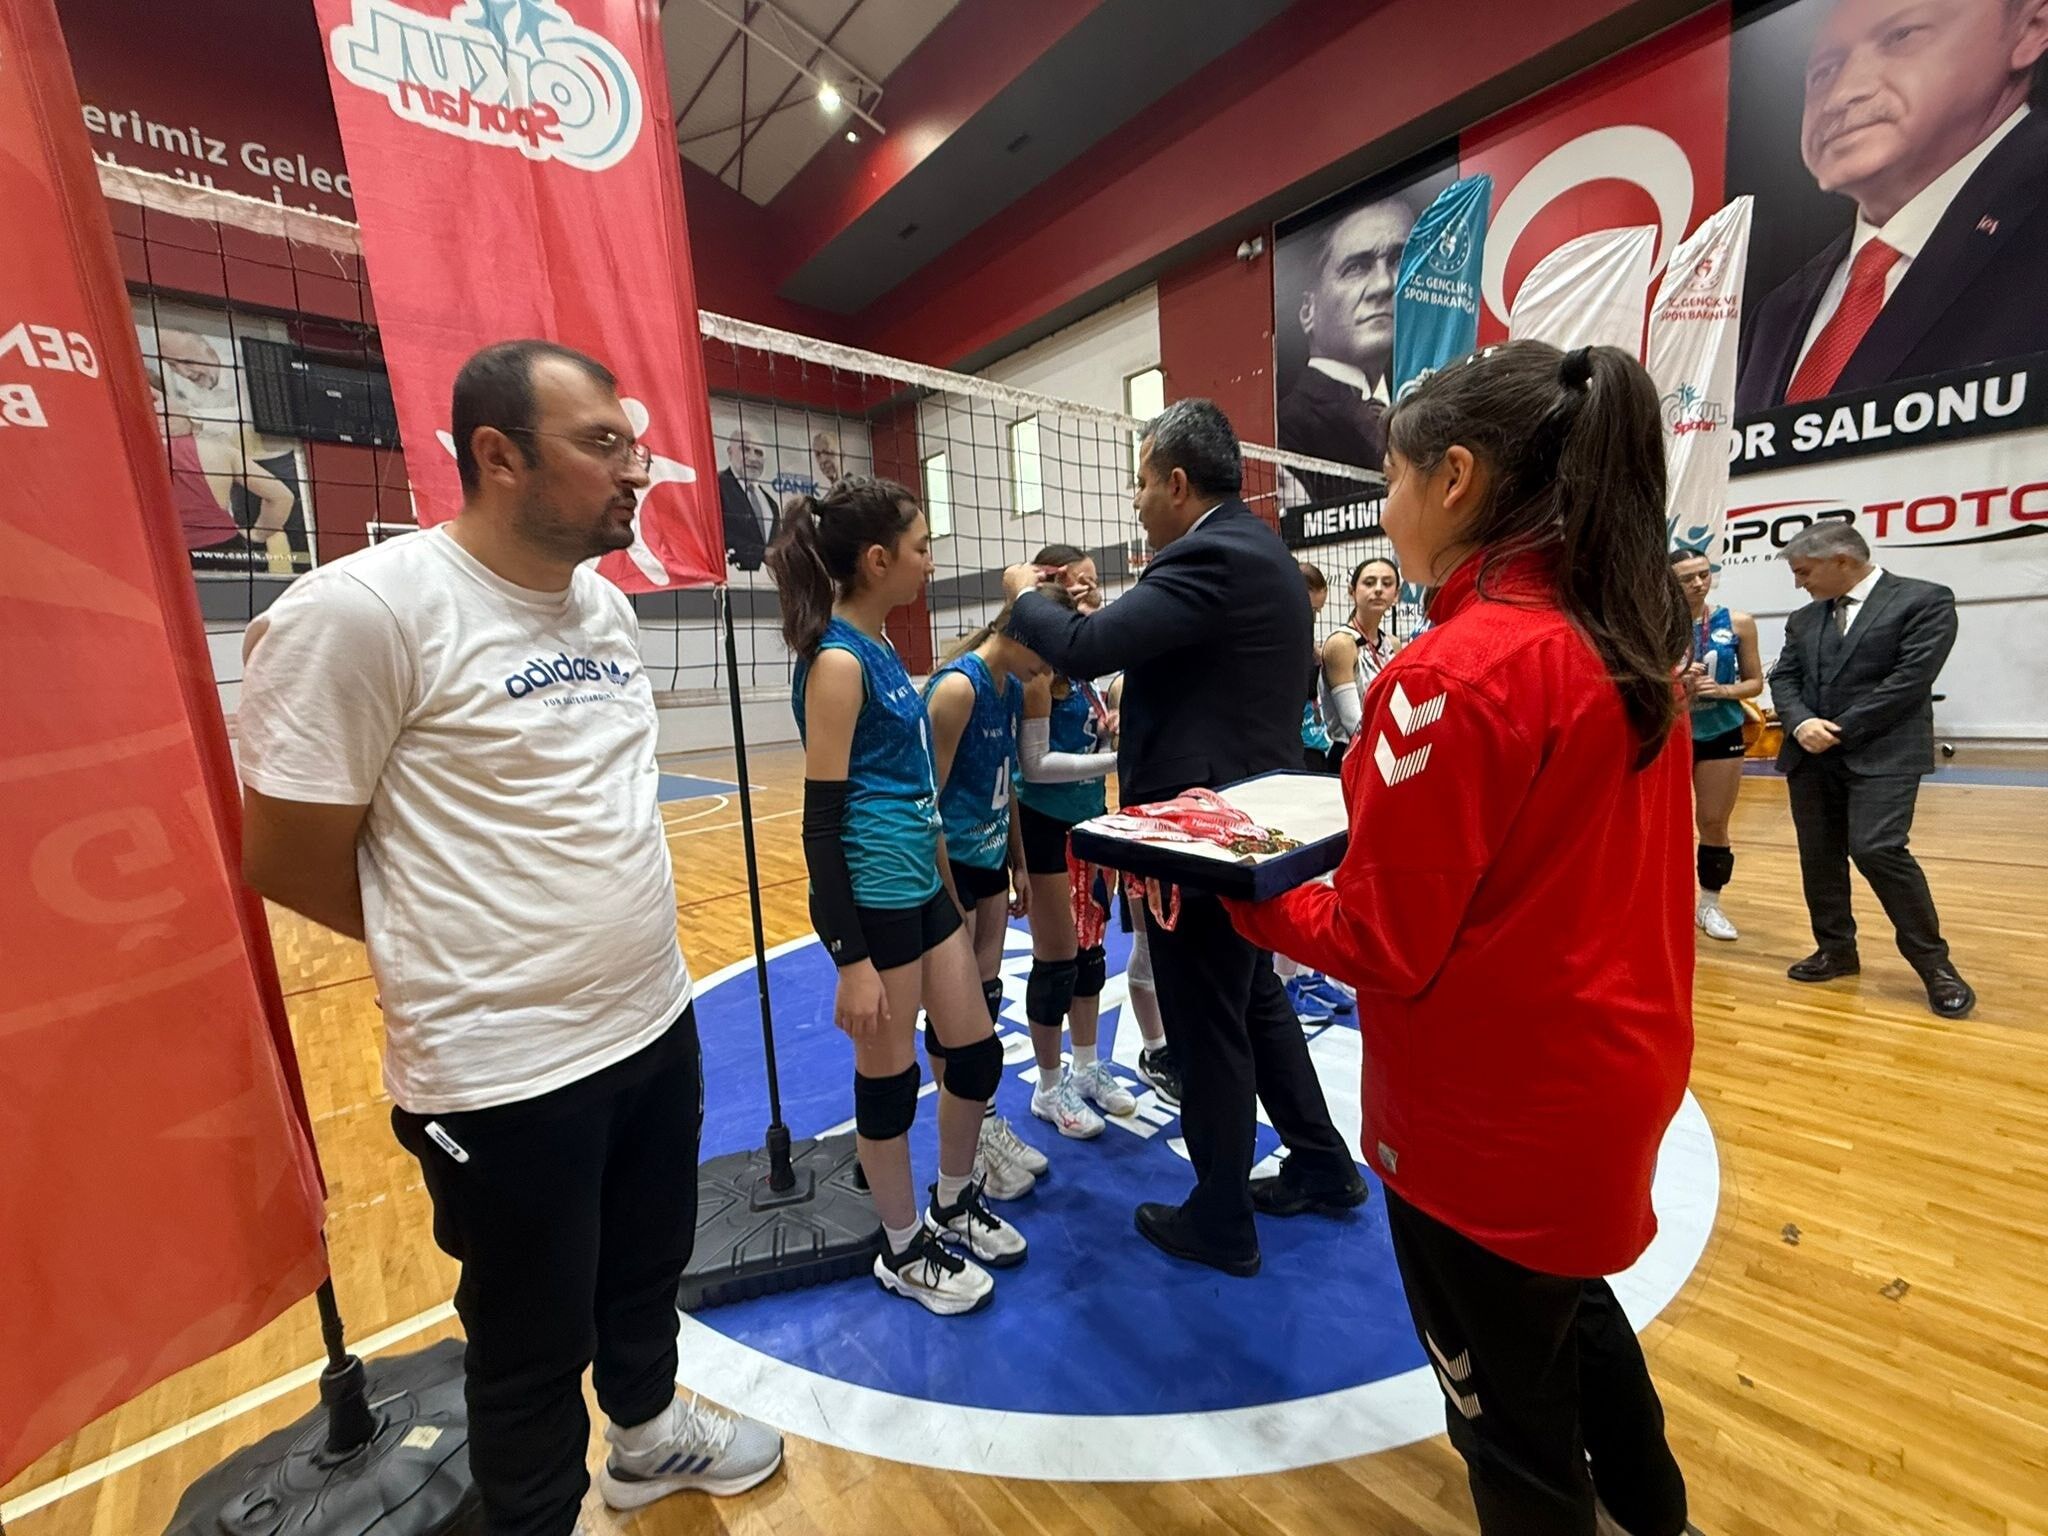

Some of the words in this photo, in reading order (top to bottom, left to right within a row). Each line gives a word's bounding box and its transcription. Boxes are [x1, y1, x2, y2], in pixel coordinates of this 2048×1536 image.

[1404, 286, 1430, 304] SPOR
[1791, 371, 2027, 452] SALONU
[505, 652, 602, 699] adidas
